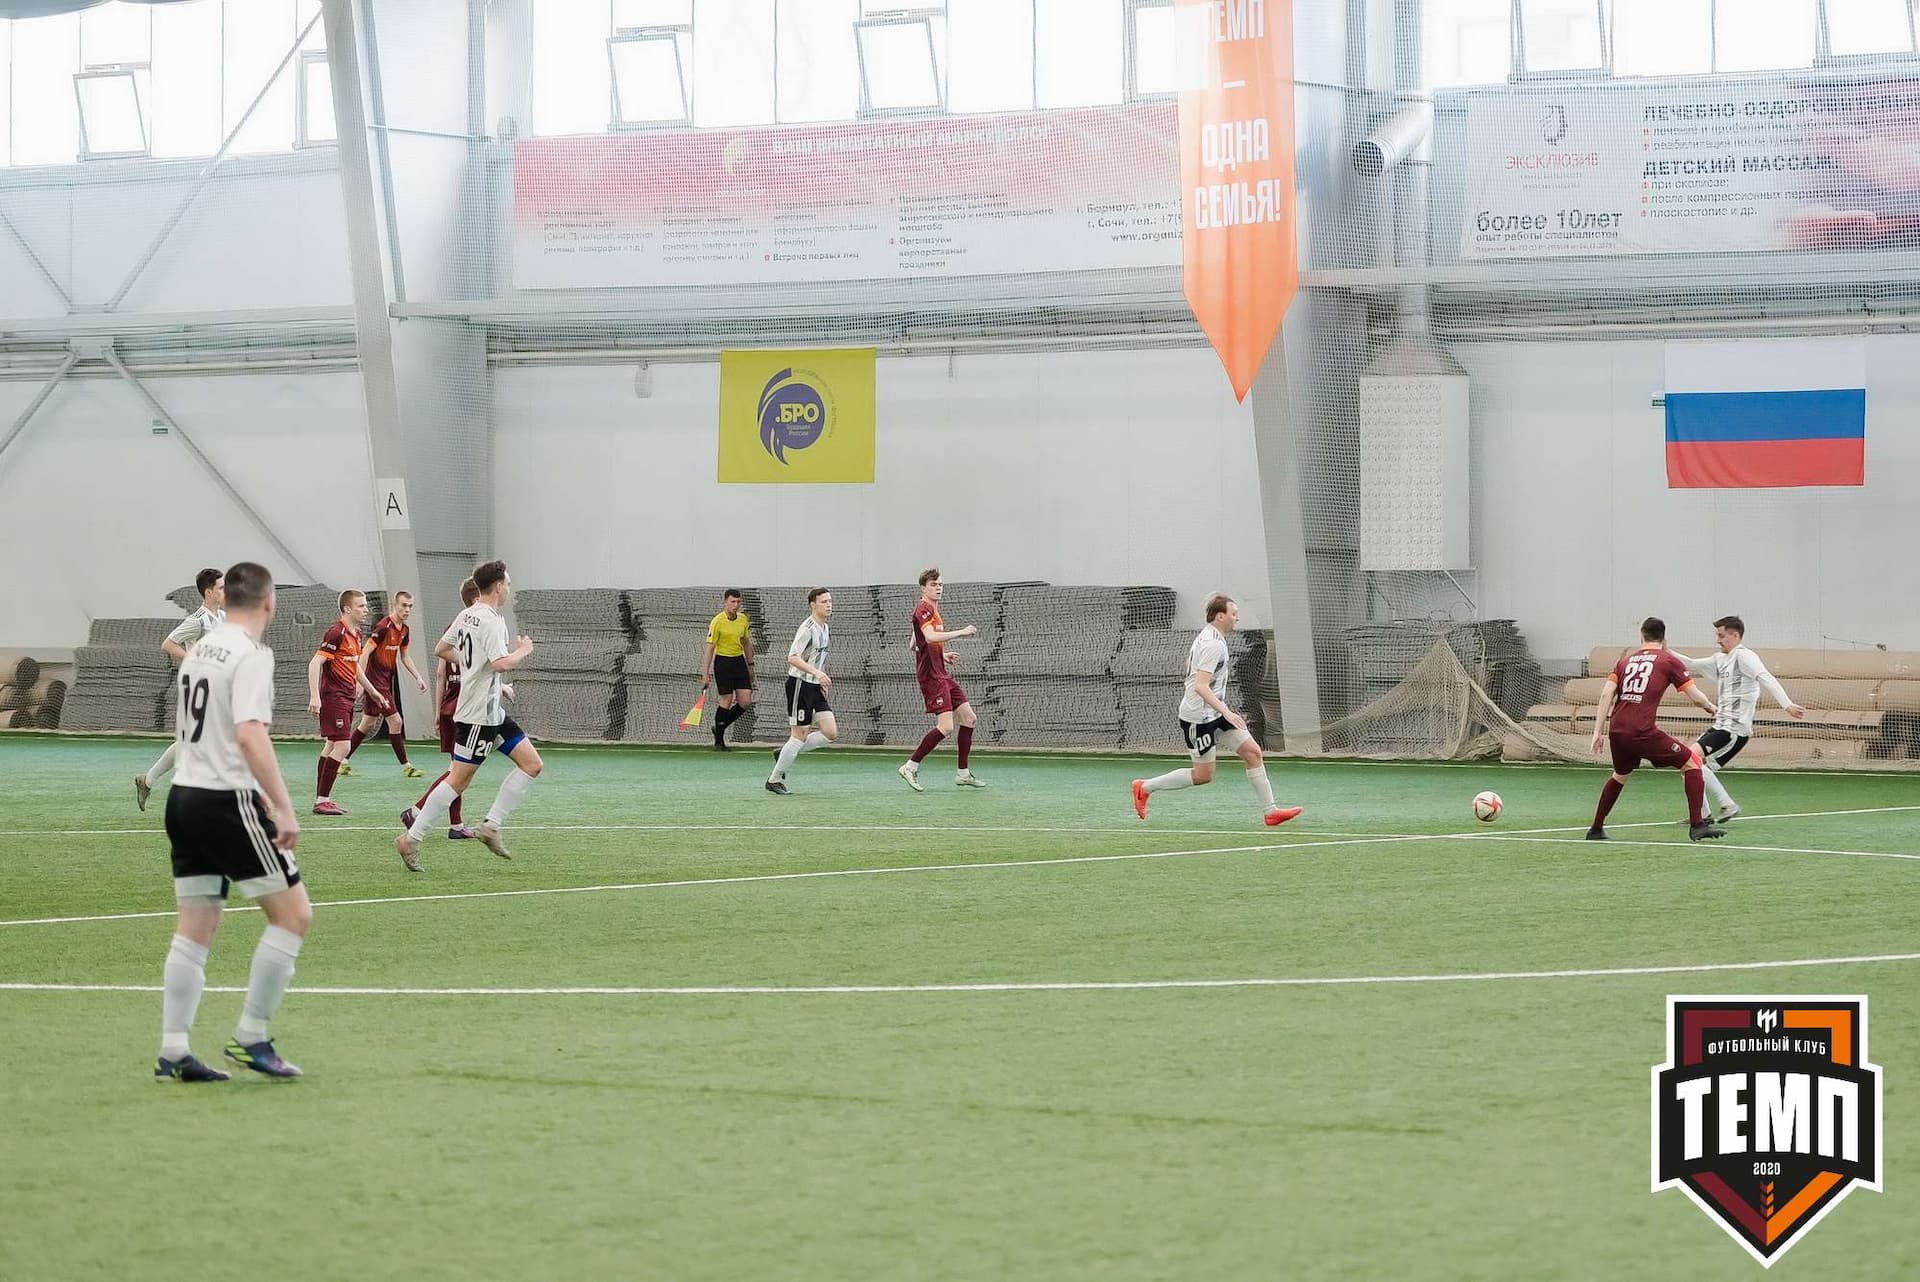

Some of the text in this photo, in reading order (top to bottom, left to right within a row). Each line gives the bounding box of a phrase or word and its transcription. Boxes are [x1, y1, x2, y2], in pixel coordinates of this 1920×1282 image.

[1202, 118, 1269, 172] ОДНА
[1505, 152, 1601, 170] ЭКСКЛЮЗИВ
[1643, 154, 1736, 179] ДЕТСКИЙ
[1651, 181, 1672, 191] при
[1195, 179, 1281, 229] СЕМЬЯ!
[1651, 195, 1683, 204] после
[1687, 190, 1781, 205] компрессионных
[1476, 208, 1623, 232] более 10лет
[1650, 207, 1758, 219] плоскостопие и др.
[1097, 217, 1128, 228] Сочи,
[1476, 230, 1618, 243] опыт работы специалистов
[1622, 661, 1653, 694] 23
[181, 672, 211, 744] 19
[798, 709, 805, 722] 8
[475, 740, 493, 757] 20
[1196, 733, 1212, 751] 10
